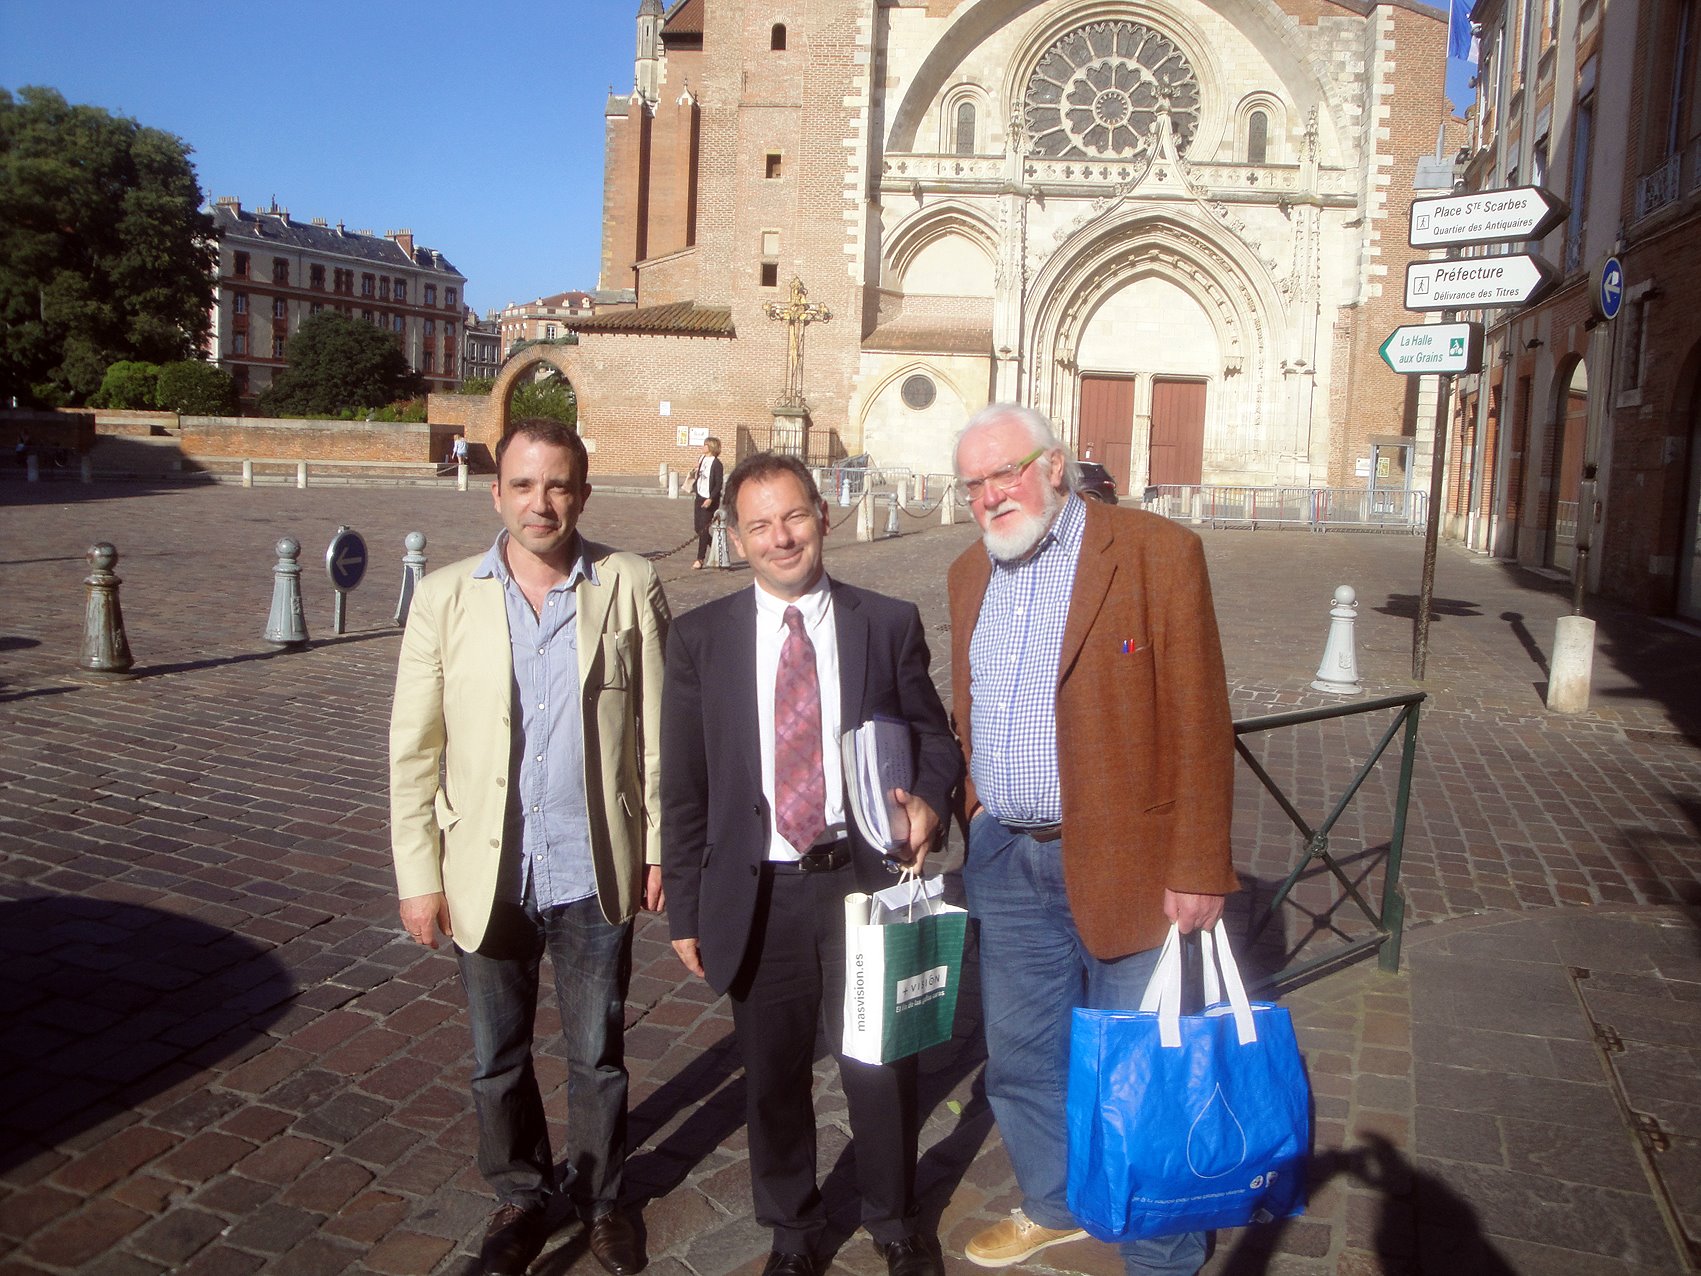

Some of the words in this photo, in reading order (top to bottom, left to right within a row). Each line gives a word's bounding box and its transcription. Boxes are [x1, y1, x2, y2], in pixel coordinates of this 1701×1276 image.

[1434, 206, 1462, 218] Place
[1483, 199, 1528, 213] Scarbes
[1433, 225, 1466, 236] Quartier
[1468, 223, 1482, 233] des
[1484, 218, 1533, 231] Antiquaires
[1435, 266, 1504, 283] Préfecture
[1433, 290, 1475, 301] Délivrance
[1477, 289, 1492, 299] des
[1496, 287, 1520, 298] Titres
[1400, 335, 1410, 347] La
[1411, 334, 1433, 346] Halle
[1399, 355, 1414, 364] aux
[1416, 351, 1444, 363] Grains
[854, 953, 865, 1032] masvision.es
